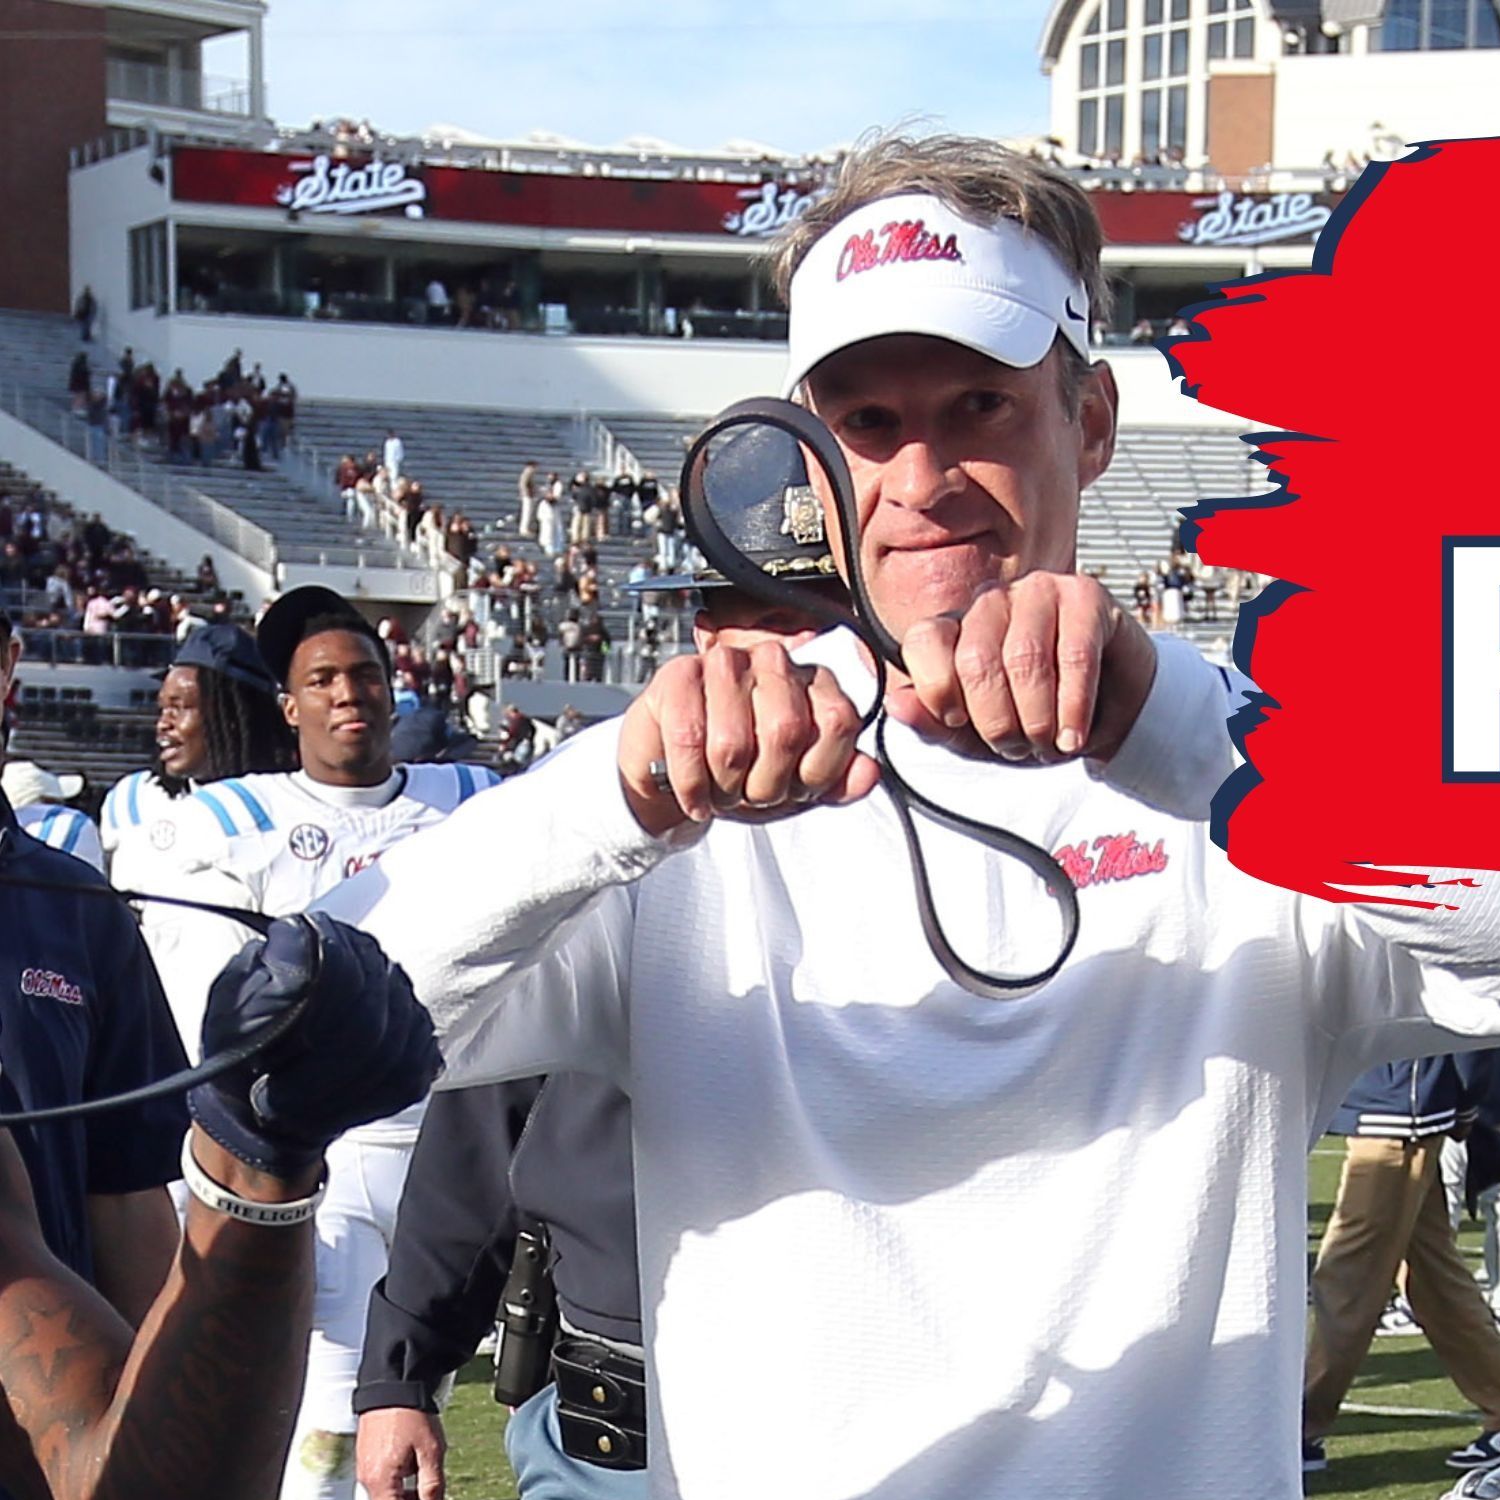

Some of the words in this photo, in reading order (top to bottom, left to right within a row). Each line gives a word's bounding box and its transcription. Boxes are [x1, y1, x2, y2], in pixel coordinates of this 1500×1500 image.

[275, 155, 426, 217] State
[1178, 191, 1332, 245] State
[837, 230, 881, 282] Ole
[880, 219, 965, 266] Miss
[289, 824, 328, 860] SEC
[21, 968, 48, 996] Ole
[45, 971, 83, 1005] Miss
